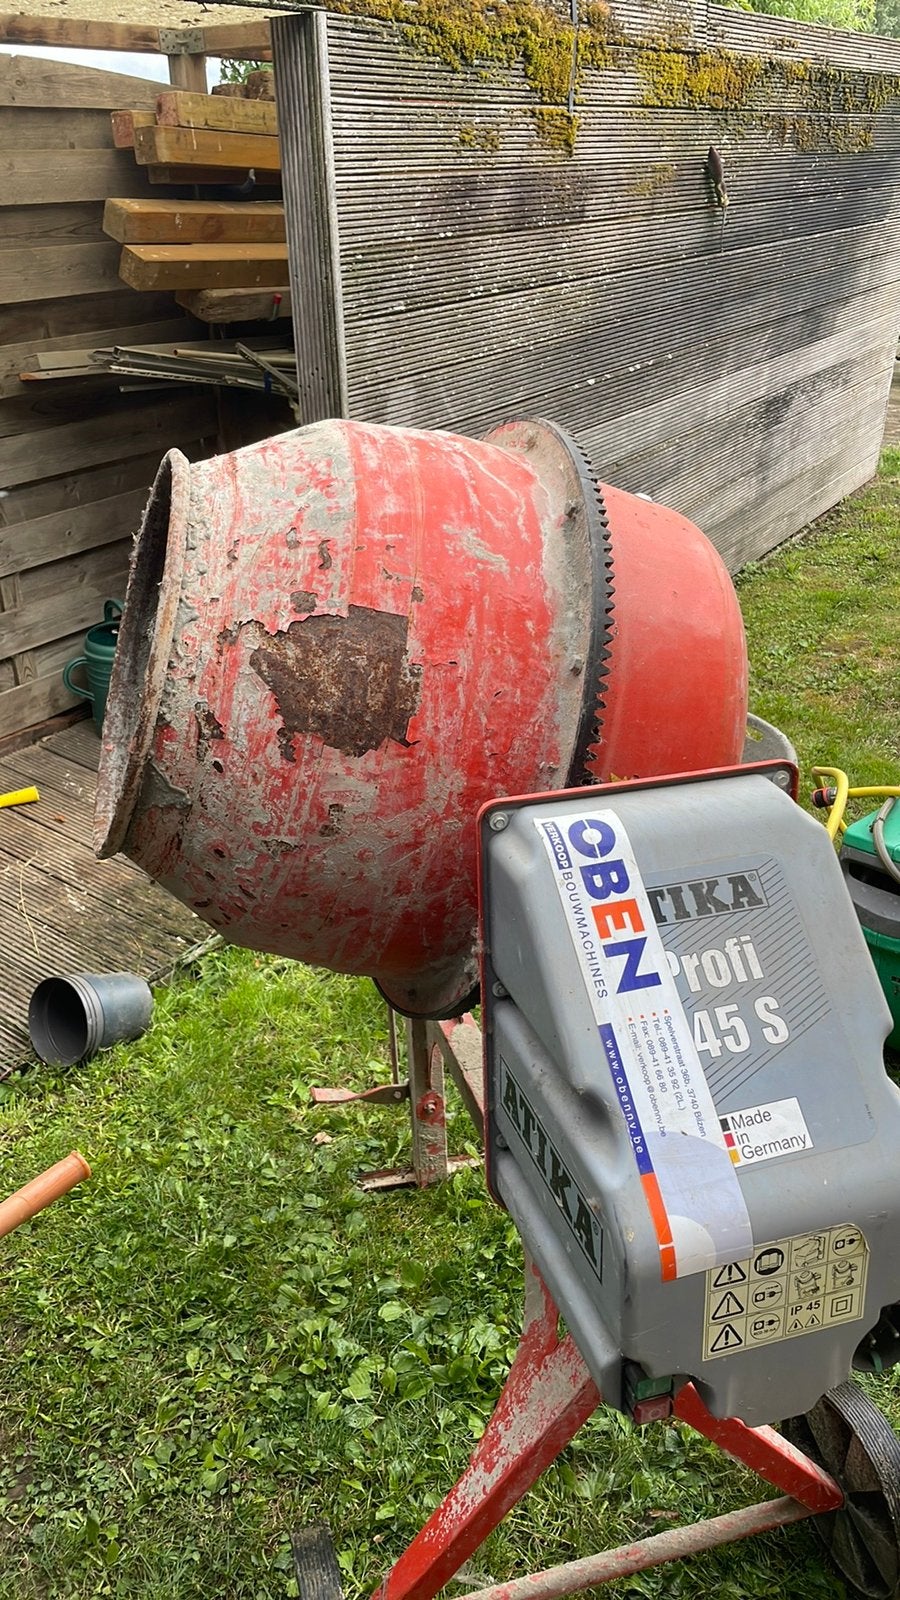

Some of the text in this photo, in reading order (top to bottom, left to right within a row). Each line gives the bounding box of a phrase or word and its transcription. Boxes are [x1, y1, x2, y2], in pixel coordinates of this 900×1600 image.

[542, 822, 608, 999] VERKOOP BOUWMACHINES
[568, 818, 662, 995] OBEN
[646, 875, 763, 923] TIKA
[694, 996, 790, 1059] 45 S
[646, 1039, 660, 1067] 089-41
[658, 1036, 672, 1064] 089-41
[655, 1070, 664, 1081] 66
[667, 1066, 676, 1078] 35
[671, 1079, 680, 1091] 92
[605, 1039, 644, 1153] www.obennv.be
[659, 1082, 668, 1093] 80
[687, 1088, 699, 1110] 3740
[731, 1109, 772, 1130] Made
[735, 1131, 750, 1145] in
[741, 1133, 807, 1160] Germany
[503, 1070, 598, 1268] ATIKA
[790, 1300, 821, 1316] IP 45
